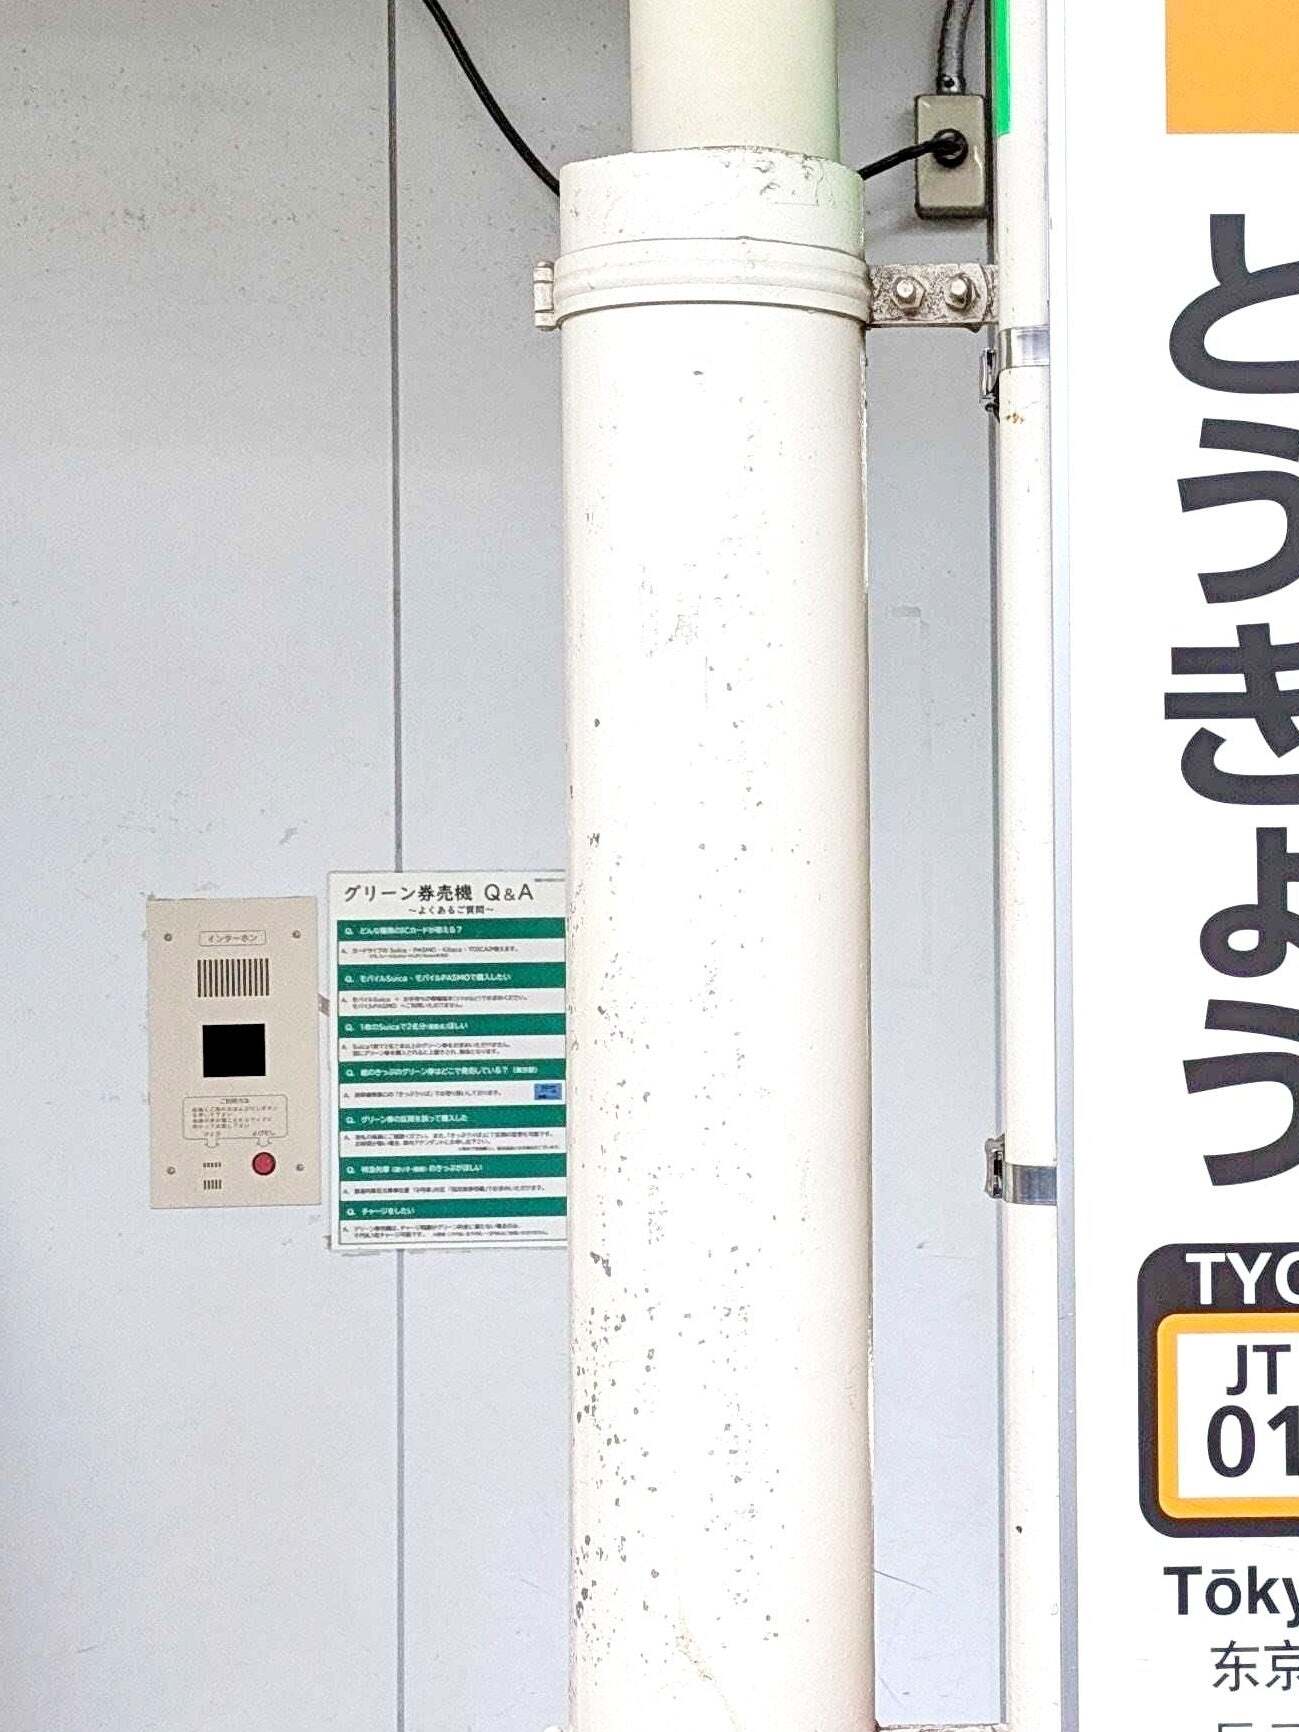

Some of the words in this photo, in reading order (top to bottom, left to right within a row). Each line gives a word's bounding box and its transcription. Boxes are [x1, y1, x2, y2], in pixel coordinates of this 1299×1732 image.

[344, 883, 472, 902] グリーン券売機
[208, 934, 258, 943] インターホン
[1226, 1344, 1291, 1396] JT
[1207, 1405, 1299, 1478] 01
